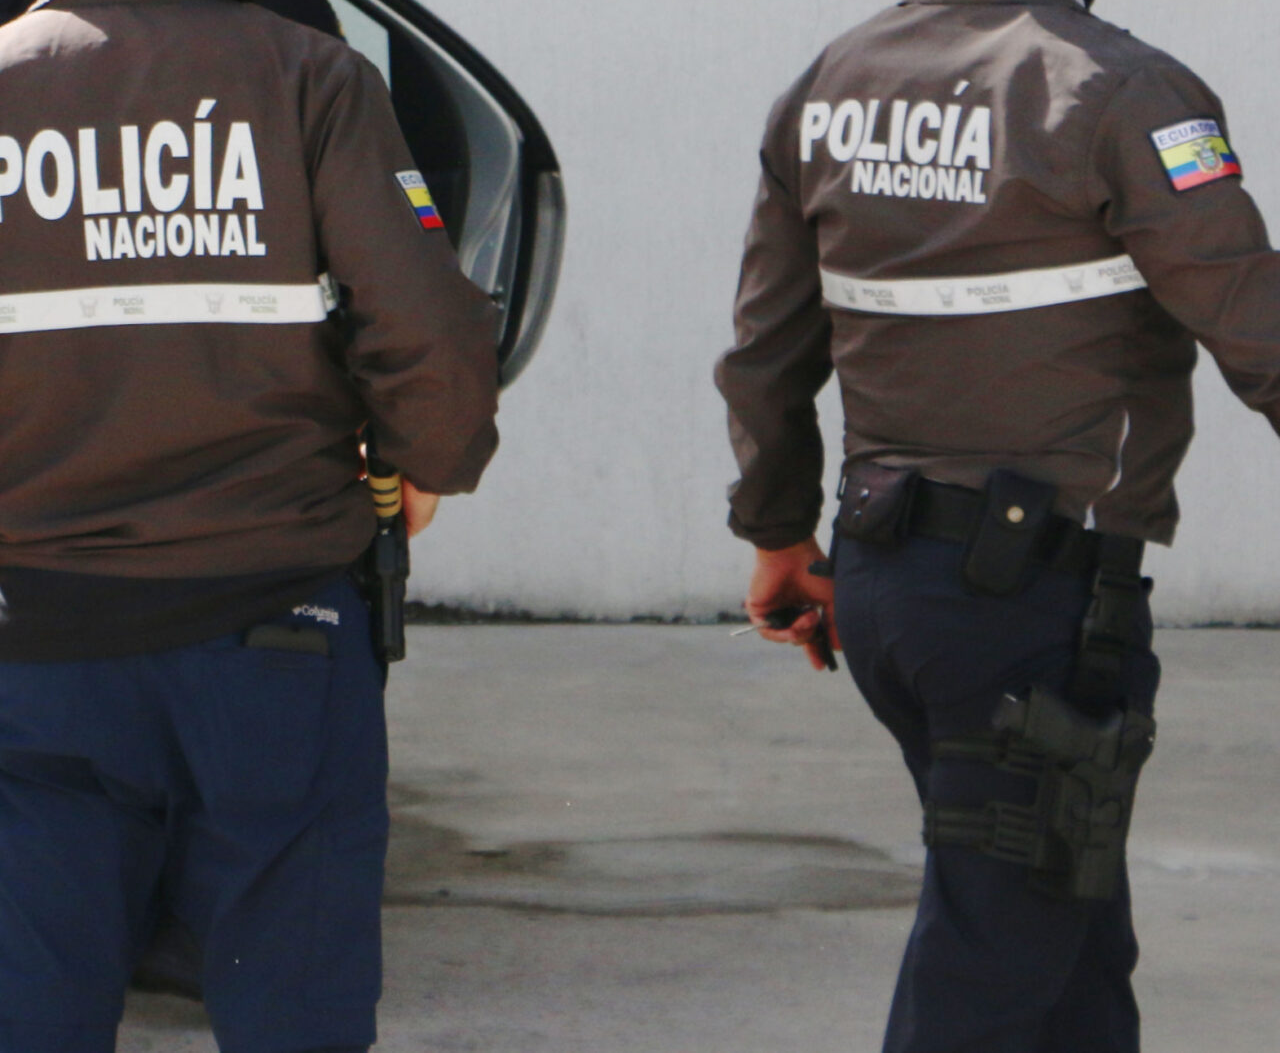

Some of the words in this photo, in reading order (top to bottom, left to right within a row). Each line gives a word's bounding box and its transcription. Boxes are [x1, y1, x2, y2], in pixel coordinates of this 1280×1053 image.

[799, 79, 991, 170] POLICÍA
[850, 160, 986, 204] NACIONAL
[83, 213, 266, 262] NACIONAL
